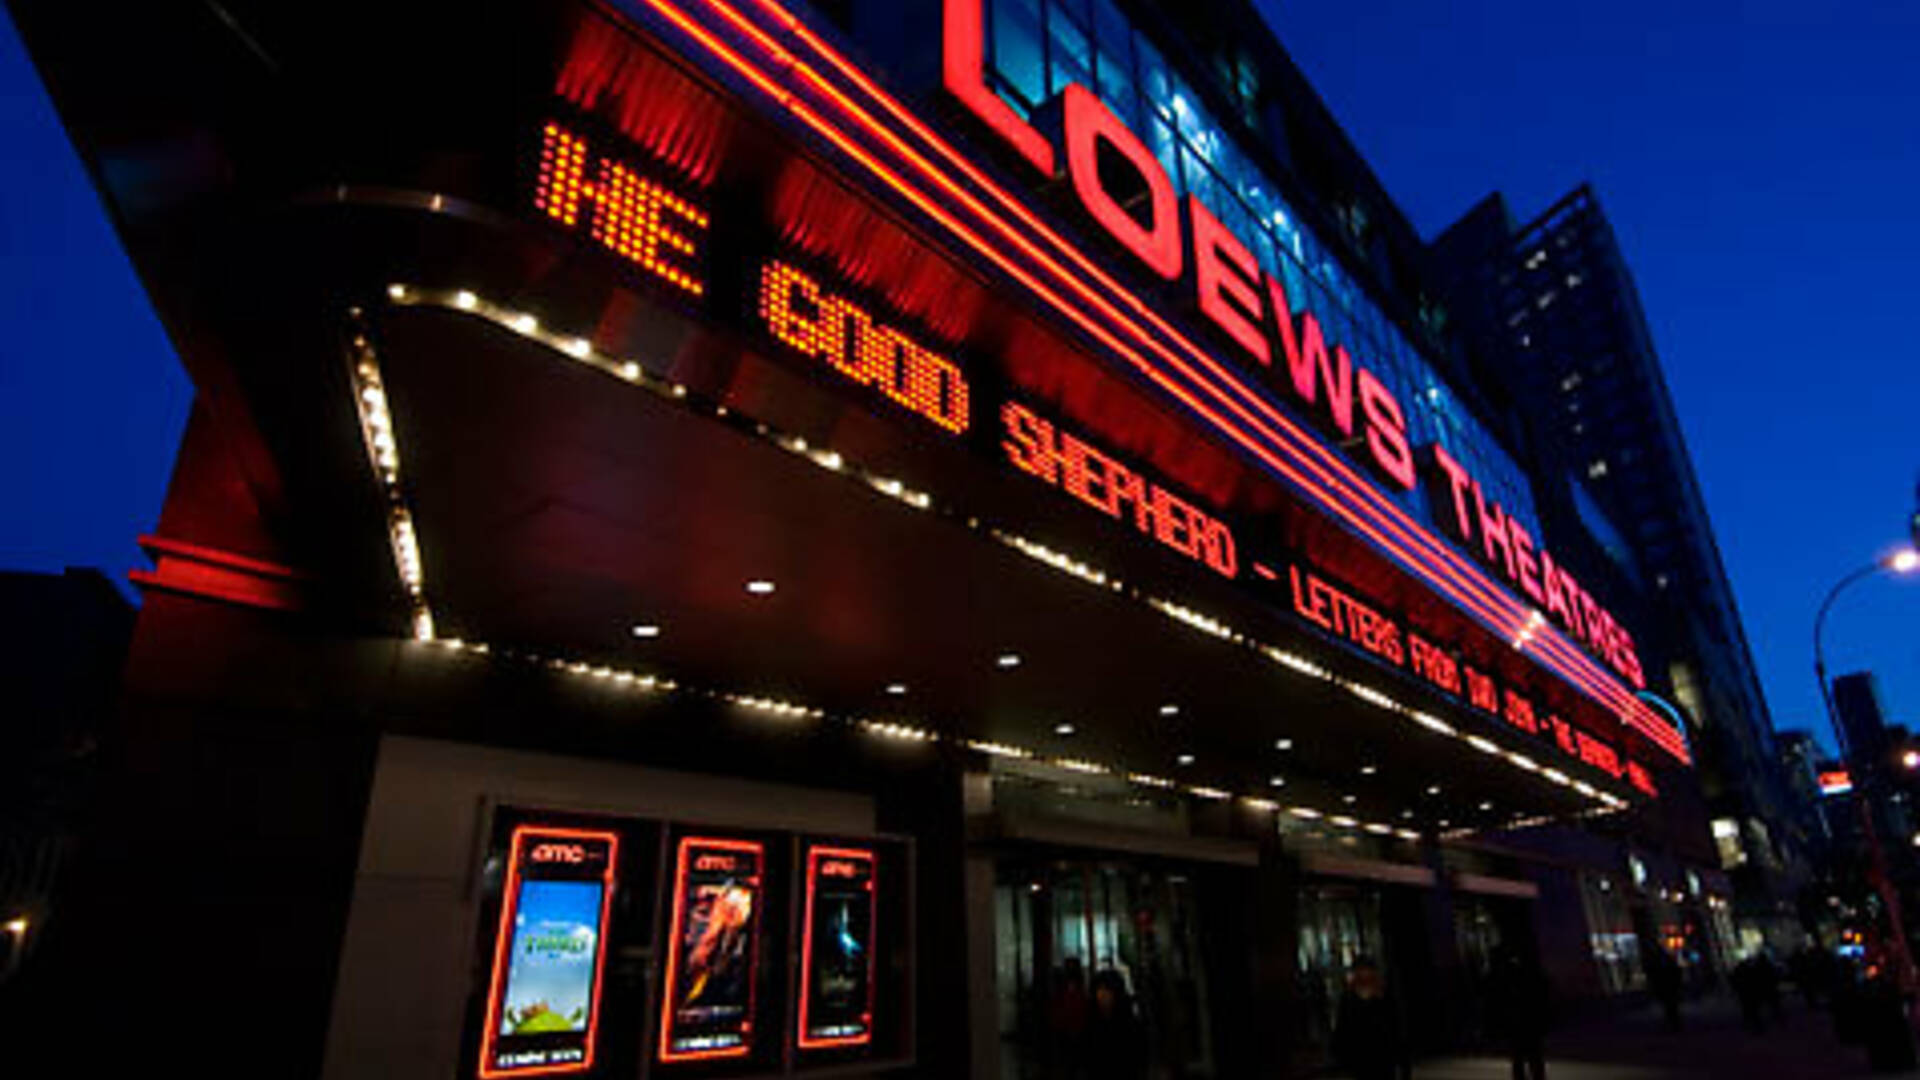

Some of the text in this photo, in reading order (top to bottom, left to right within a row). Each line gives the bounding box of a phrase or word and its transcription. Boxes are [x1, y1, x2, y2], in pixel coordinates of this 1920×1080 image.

[535, 122, 709, 296] HE
[759, 259, 969, 435] GOOD
[1001, 400, 1239, 580] SHEPHERD
[1289, 563, 1404, 666] LETTERS
[943, 0, 1646, 689] LOEWS THEATRES
